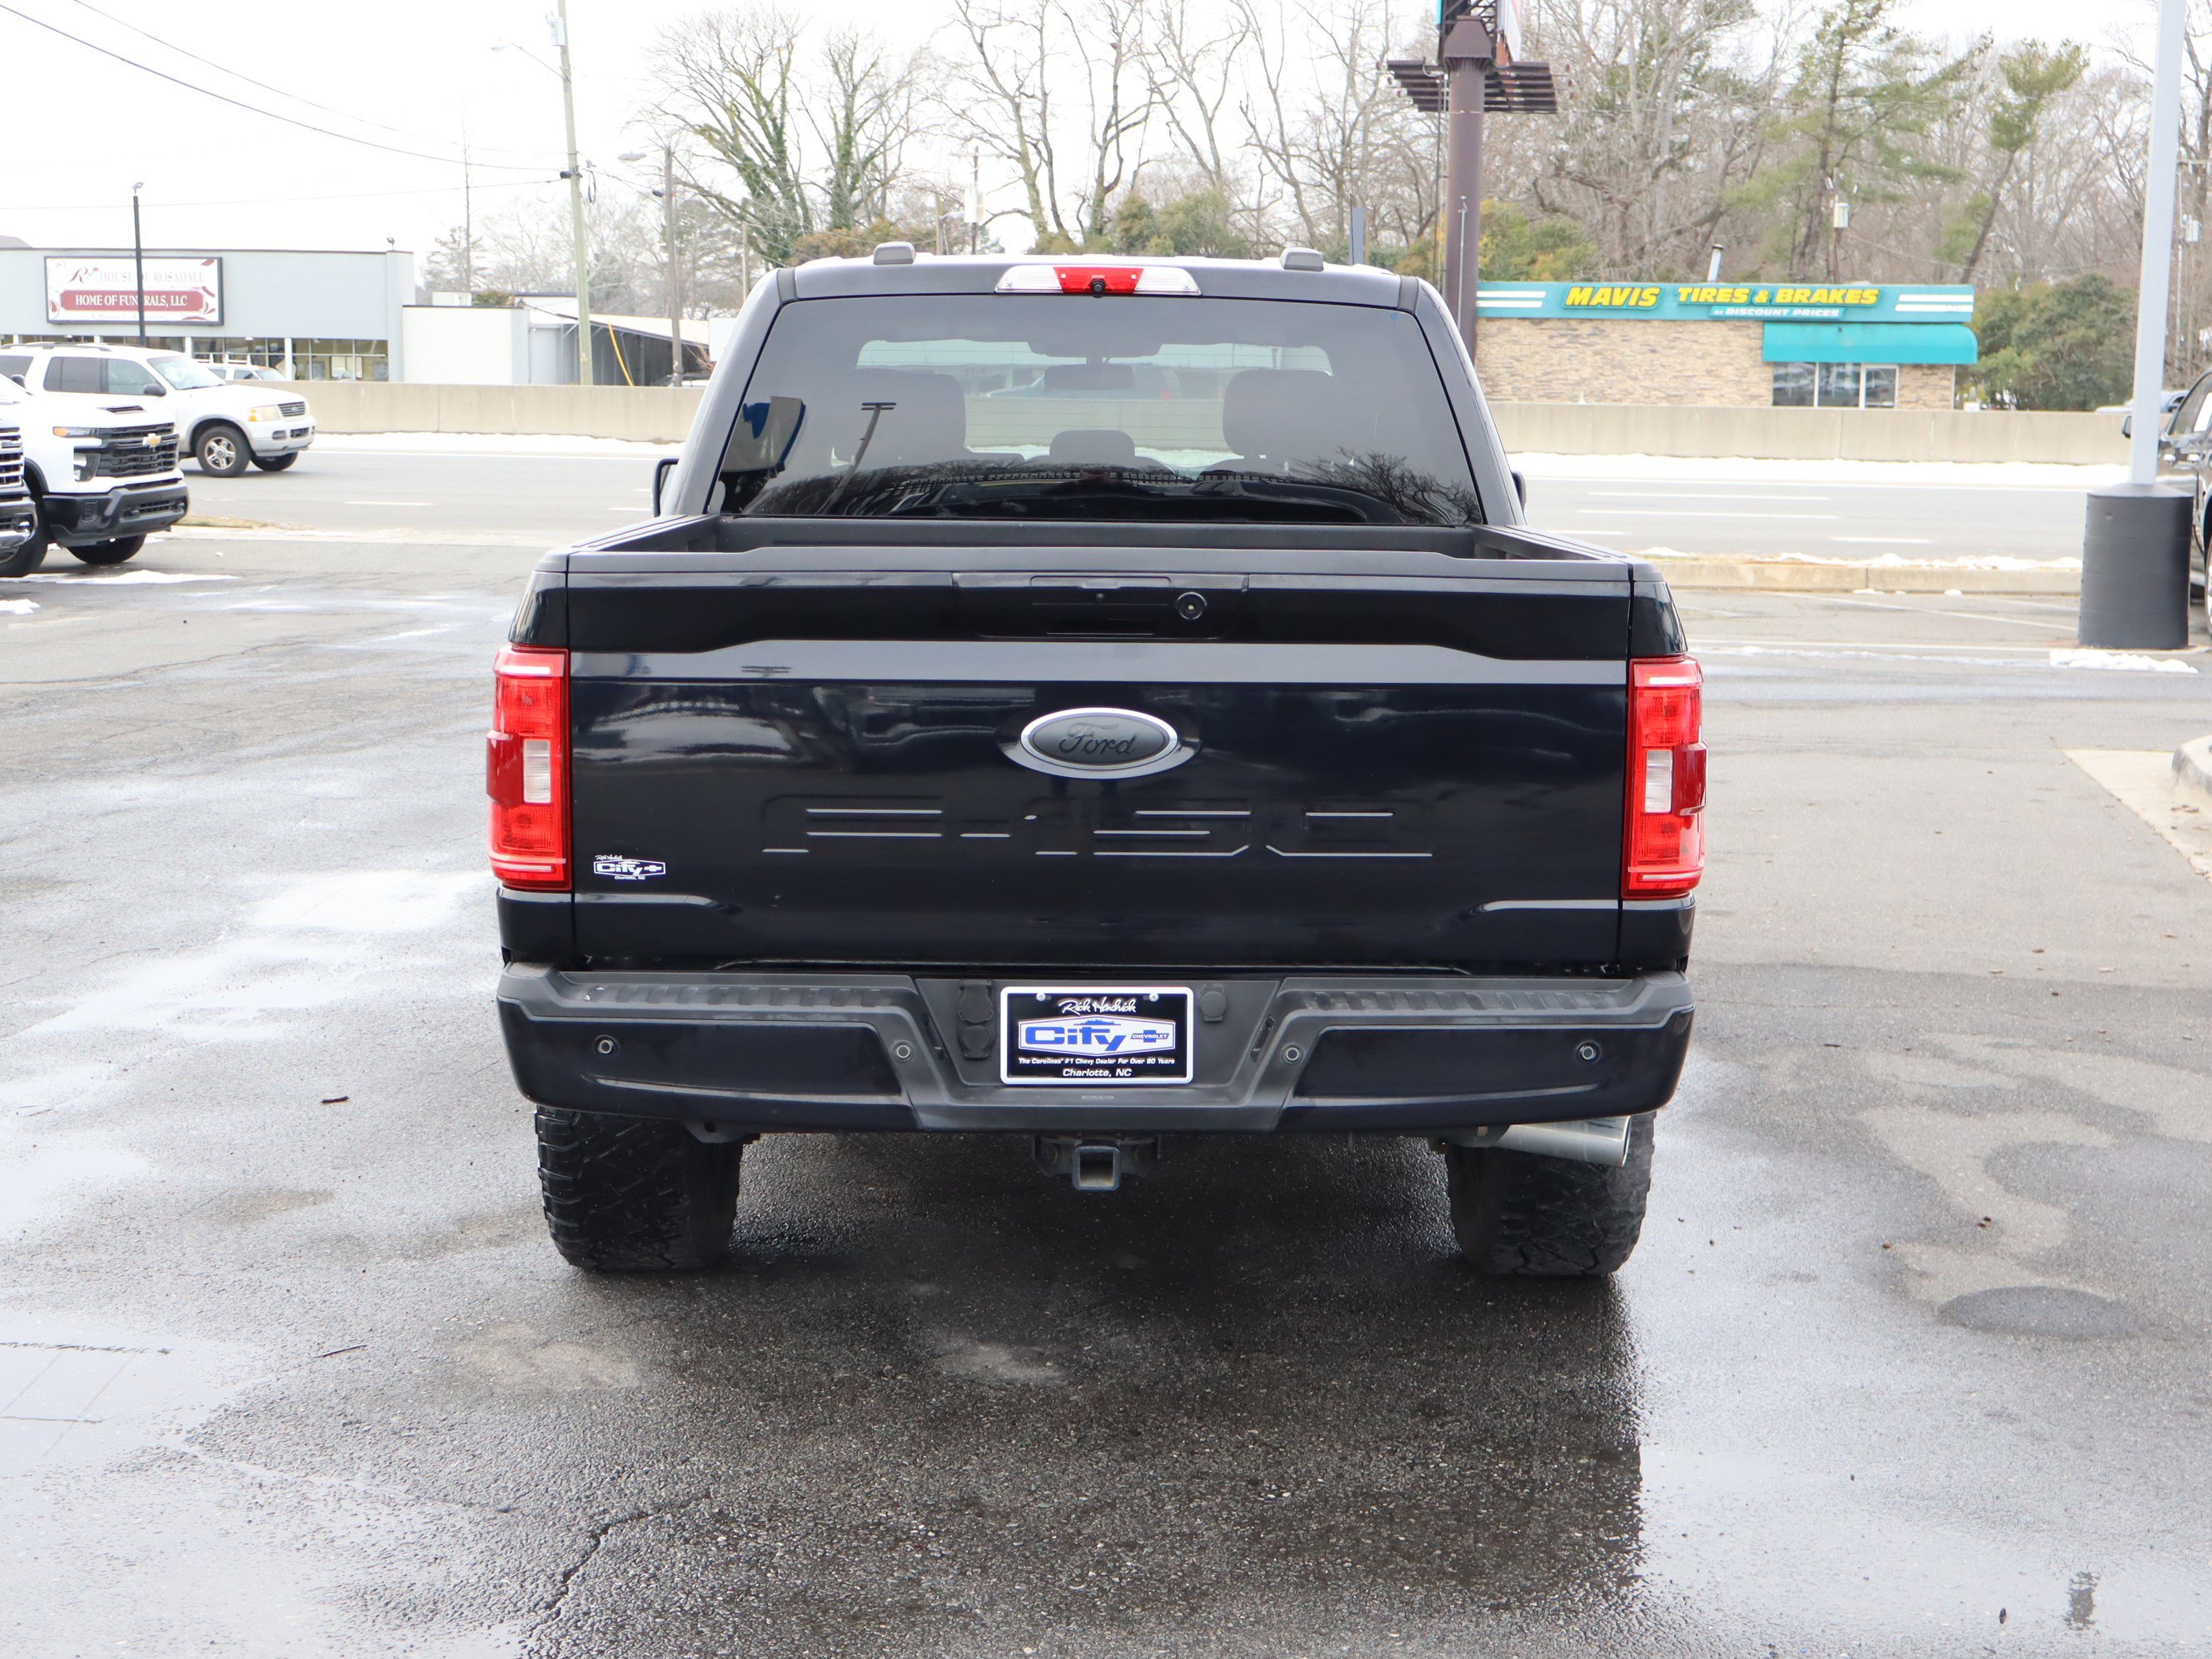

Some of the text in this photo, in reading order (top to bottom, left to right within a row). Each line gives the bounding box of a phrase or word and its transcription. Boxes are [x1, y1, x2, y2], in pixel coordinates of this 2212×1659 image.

[100, 272, 134, 282] HOUSE
[154, 272, 204, 282] ROSADALE
[75, 295, 188, 307] HOME OF FUNRALS, LLC
[1566, 286, 1661, 307] MAVIS
[1677, 286, 1880, 305] TIRES & BRAKES
[1725, 307, 1790, 316] DISCOUNT
[1791, 309, 1841, 317] PRICES
[1059, 722, 1139, 755] Ford
[596, 863, 643, 875] City
[1059, 996, 1137, 1015] Rick Hendrick
[1025, 1027, 1127, 1051] City
[1063, 1068, 1133, 1078] Charlotte, NC
